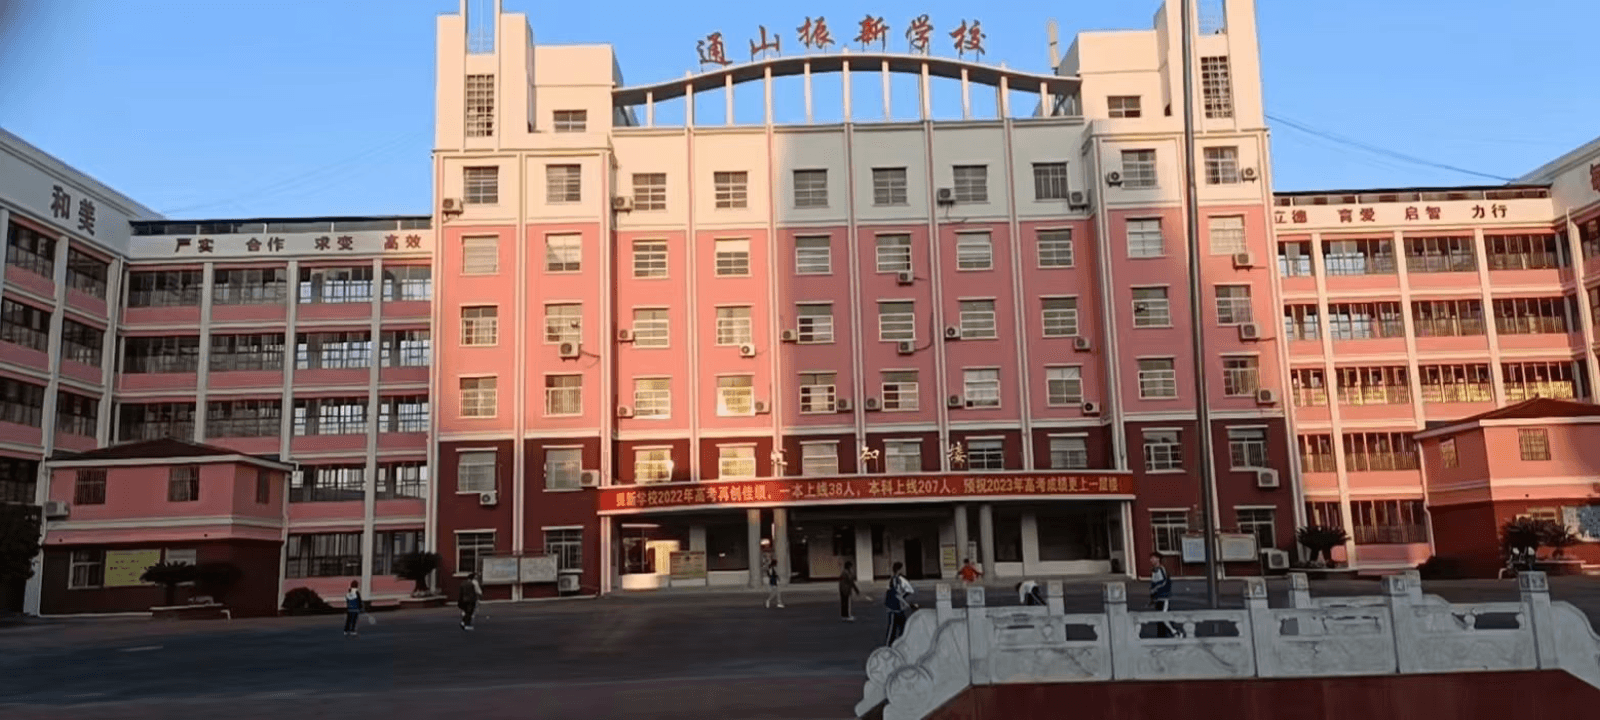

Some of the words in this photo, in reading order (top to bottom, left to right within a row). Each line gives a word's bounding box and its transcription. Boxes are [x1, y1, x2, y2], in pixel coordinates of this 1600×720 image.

[697, 14, 986, 66] 通山振新学校
[51, 184, 95, 236] 和美
[1274, 209, 1308, 224] 立德
[1337, 208, 1376, 223] 育爱
[1405, 206, 1441, 221] 启智
[1472, 203, 1508, 219] 力行
[174, 238, 215, 253] 严实
[246, 236, 285, 252] 合作
[314, 235, 355, 251] 求变
[384, 234, 422, 250] 高效
